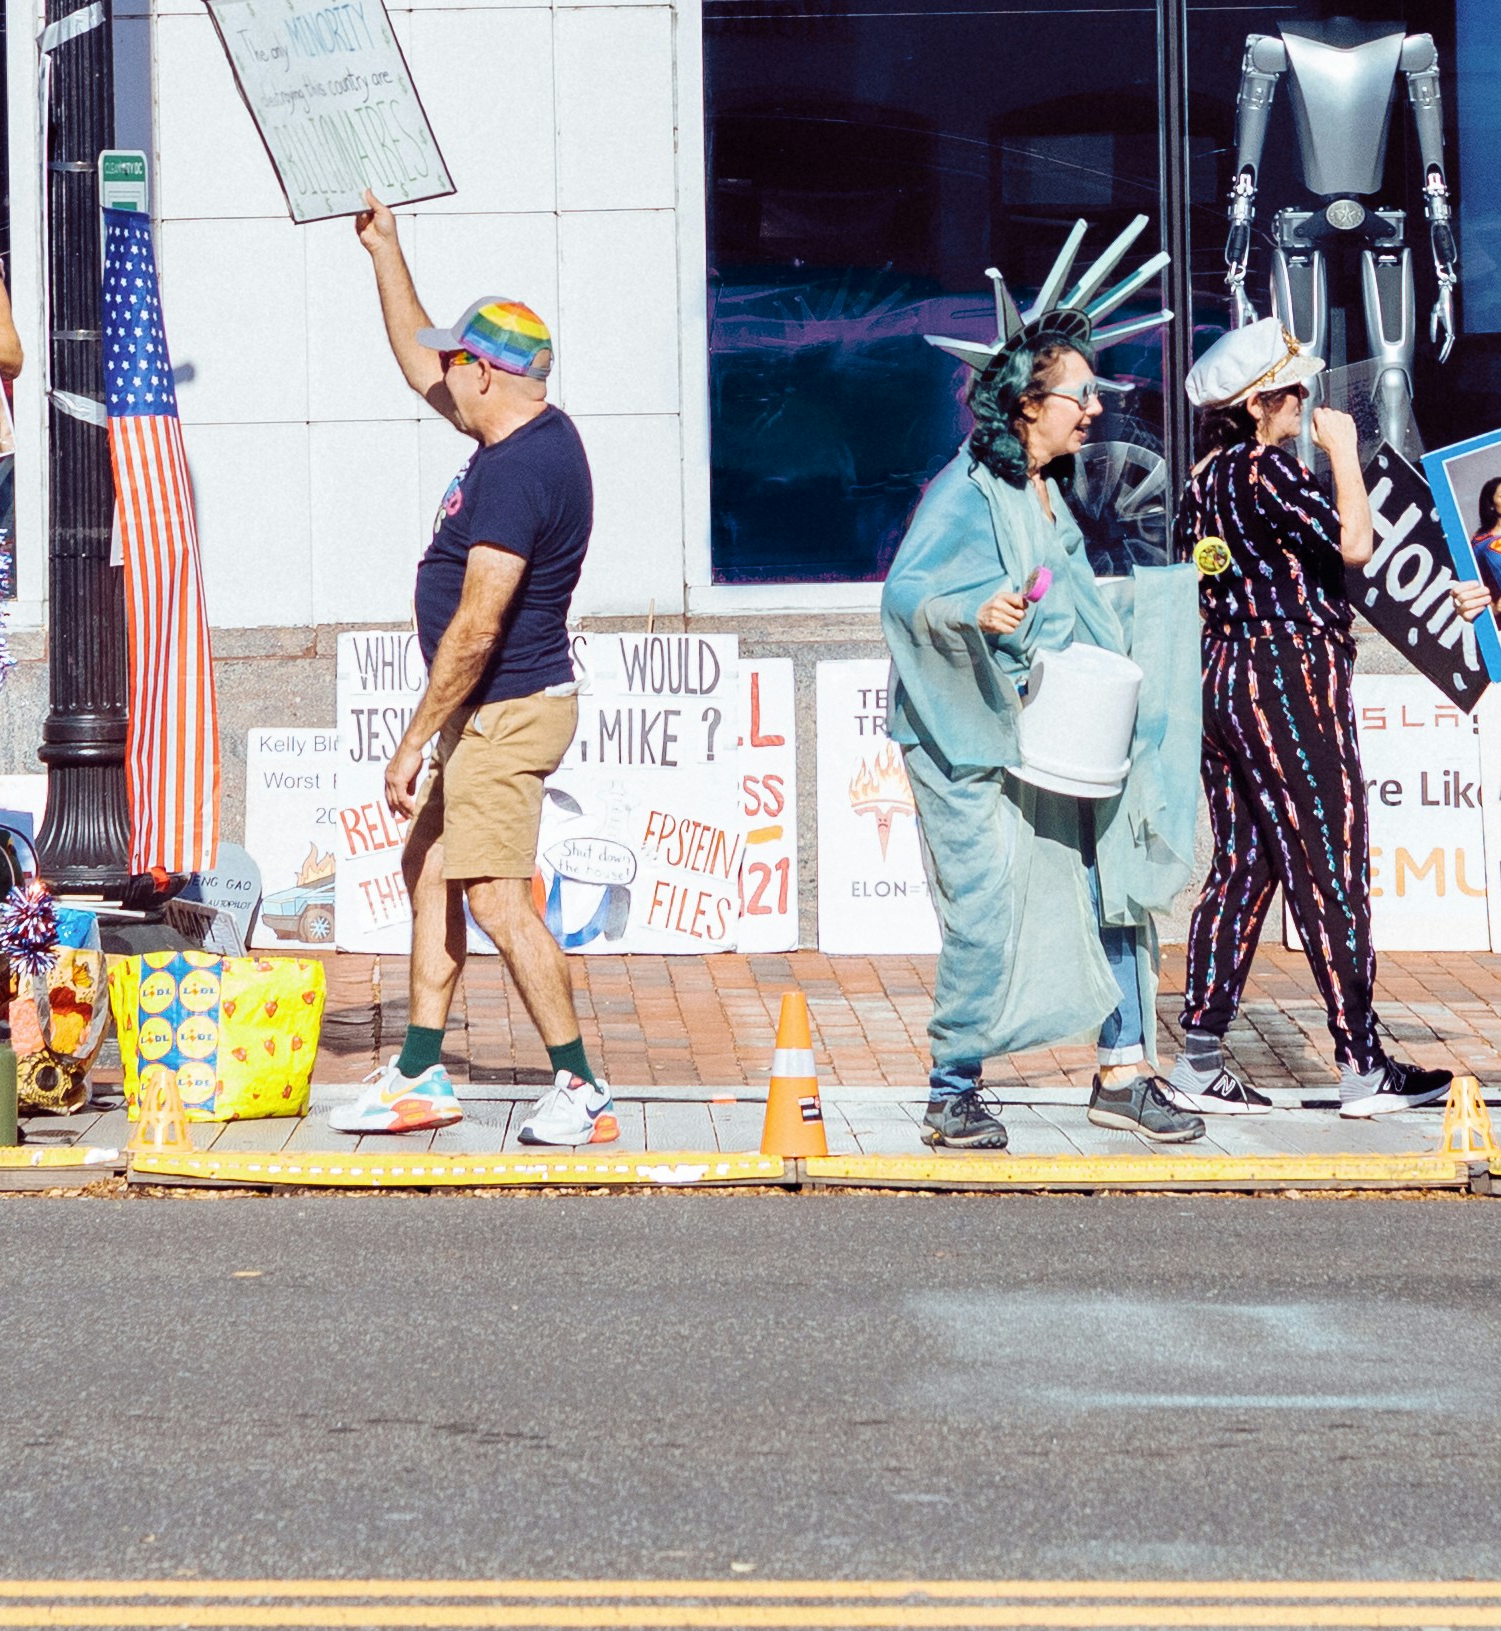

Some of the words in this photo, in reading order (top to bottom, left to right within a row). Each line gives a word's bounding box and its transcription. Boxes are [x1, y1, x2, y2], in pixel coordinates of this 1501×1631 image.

[236, 28, 269, 63] The
[283, 1, 376, 58] MINORITY
[328, 66, 370, 104] country
[371, 69, 394, 87] are
[353, 634, 426, 692] WHIC
[619, 636, 721, 695] WOULD
[260, 735, 307, 757] Kelly
[314, 735, 338, 752] Bl
[350, 708, 433, 762] JES
[599, 707, 682, 767] MIKE
[701, 706, 722, 761] ?
[263, 772, 320, 789] Worst
[1364, 778, 1403, 807] re
[1420, 770, 1483, 809] Lik
[558, 859, 581, 873] the
[562, 840, 593, 858] Shut
[598, 846, 631, 864] down
[642, 810, 740, 879] EPSTEIN
[192, 874, 219, 888] ENG
[226, 878, 252, 891] GAO
[1368, 847, 1487, 897] EMU
[208, 899, 252, 909] AUTOPILOT
[647, 879, 732, 941] FILES
